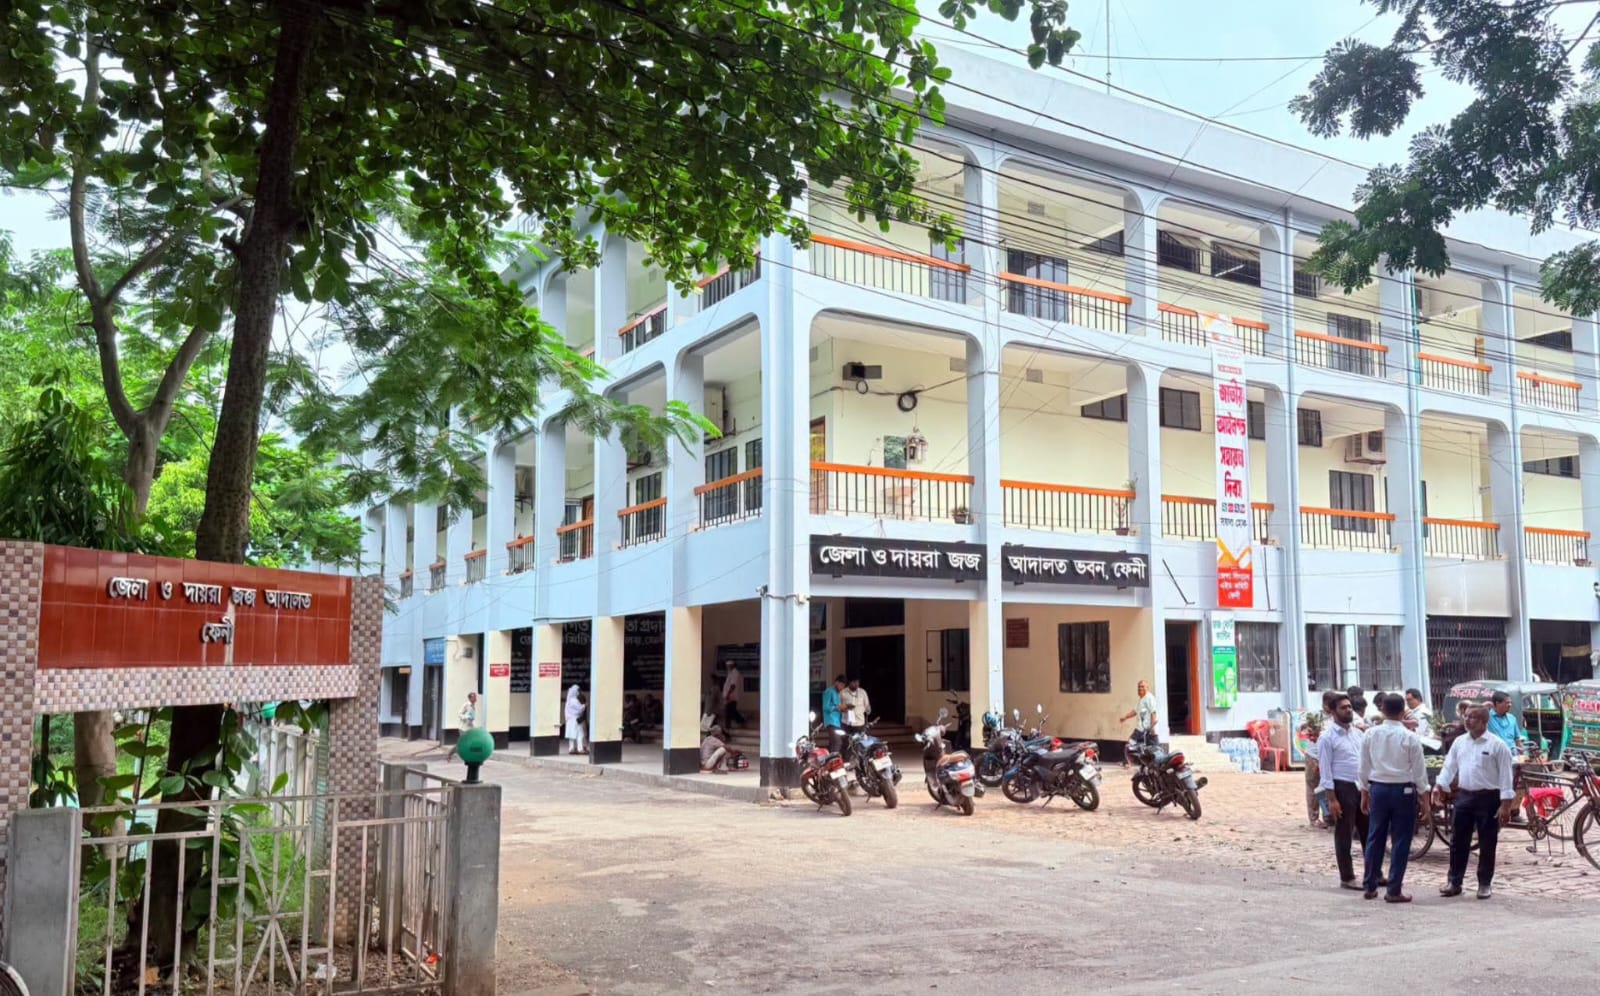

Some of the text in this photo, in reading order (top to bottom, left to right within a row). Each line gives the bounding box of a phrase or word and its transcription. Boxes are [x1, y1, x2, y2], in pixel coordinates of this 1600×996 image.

[1219, 379, 1244, 408] জাতীয়
[1224, 471, 1243, 499] দিবস
[819, 545, 982, 572] জেলা ও দায়রা জজ
[1008, 555, 1146, 580] আদালত ভবন, ফেনী
[108, 576, 313, 609] জেলা ও দায়রা জজ আদালত
[202, 616, 235, 644] ফেনী
